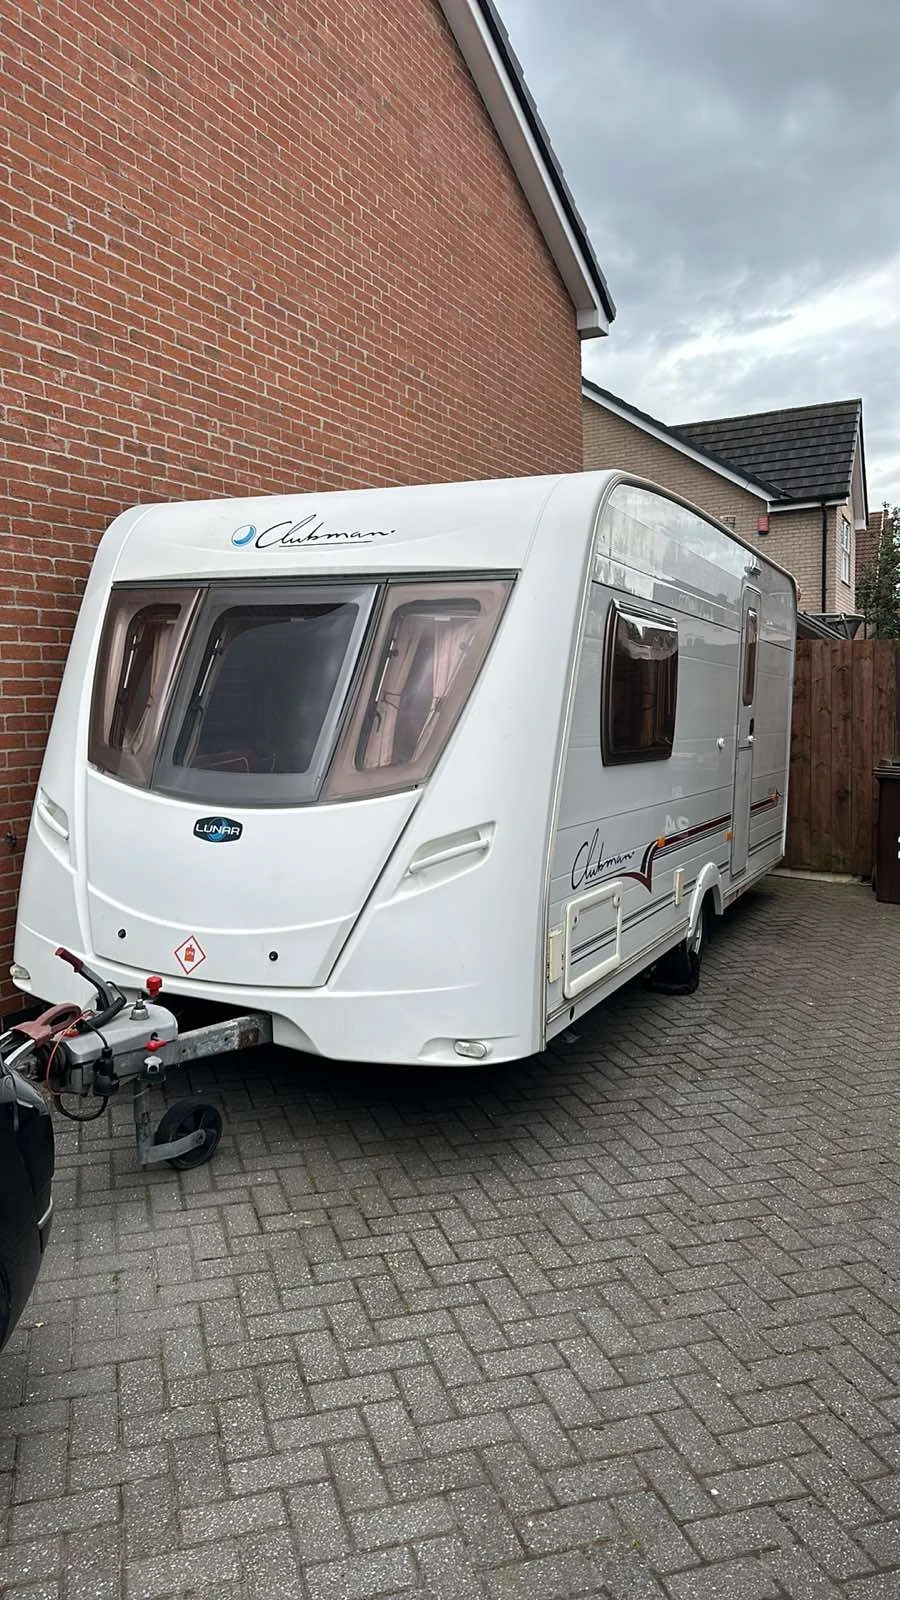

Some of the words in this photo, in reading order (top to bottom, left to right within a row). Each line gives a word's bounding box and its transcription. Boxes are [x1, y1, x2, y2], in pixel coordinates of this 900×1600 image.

[255, 513, 394, 549] Clubman
[195, 823, 240, 836] LUNAR
[571, 827, 635, 890] Clubman
